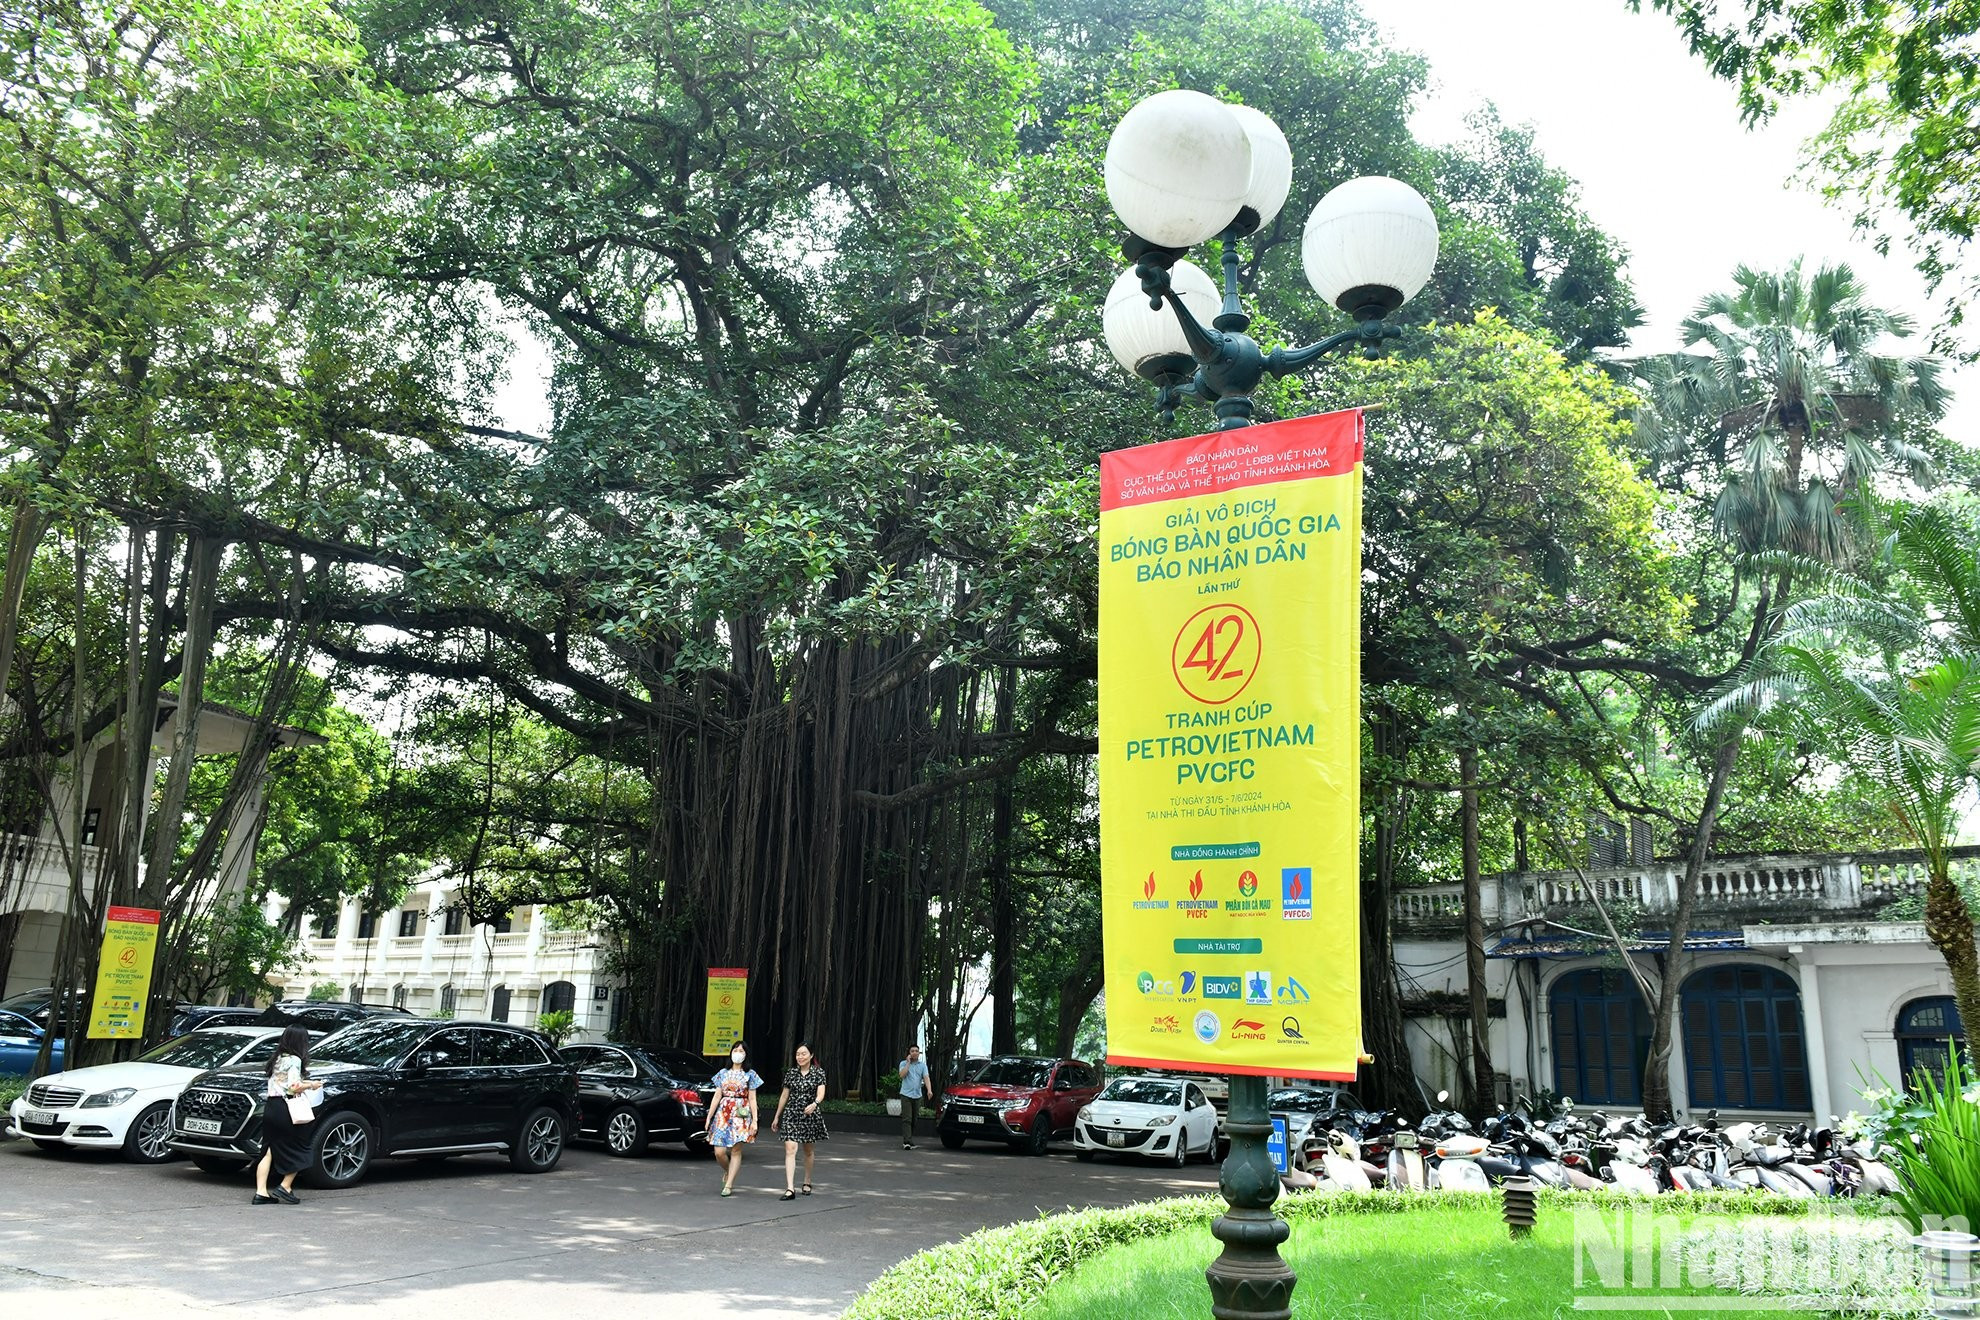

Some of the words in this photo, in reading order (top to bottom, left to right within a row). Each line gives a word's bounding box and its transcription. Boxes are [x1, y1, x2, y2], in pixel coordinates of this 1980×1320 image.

[1186, 453, 1206, 465] BÁO
[1208, 448, 1235, 461] NHÂN
[1237, 444, 1259, 456] DÂN
[1123, 476, 1144, 488] CỤC
[1146, 469, 1165, 483] THỂ
[1166, 469, 1188, 481] DỤC
[1190, 462, 1209, 476] THỂ
[1212, 460, 1237, 473] THAO
[1246, 454, 1274, 467] LĐBB
[1276, 449, 1300, 461] VIỆT
[1303, 447, 1327, 458] NAM
[1120, 488, 1134, 500] SỞ
[1135, 486, 1155, 497] VĂN
[1156, 482, 1176, 494] HÓA
[1178, 479, 1191, 490] VÀ
[1193, 474, 1213, 487] THỂ
[1216, 472, 1241, 484] THAO
[1243, 467, 1267, 478] TỈNH
[1268, 462, 1306, 475] KHÁNH
[1308, 458, 1330, 470] HÒA
[1165, 507, 1199, 528] GIẢI
[1206, 503, 1228, 522] VÔ
[1233, 498, 1276, 517] ĐỊCH
[1111, 536, 1168, 562] BÓNG
[1175, 527, 1220, 552] BÀN
[1227, 510, 1291, 544] QUỐC
[1298, 513, 1341, 534] GIA
[1137, 557, 1181, 582] BÁO
[1188, 547, 1248, 577] NHÂN
[1255, 538, 1306, 564] DÂN
[1198, 581, 1218, 595] LẦN
[1220, 578, 1241, 592] THỨ
[1181, 614, 1244, 681] 42
[1165, 709, 1230, 729] TRANH
[1235, 700, 1272, 723] CÚP
[1127, 724, 1314, 761] PETROVIETNAM
[1177, 758, 1255, 785] PVCFC
[1170, 796, 1182, 806] TỪ
[1182, 794, 1204, 805] NGÀY
[1205, 795, 1224, 804] 31/5
[1231, 792, 1262, 803] 7/6/2024
[1159, 808, 1179, 819] NHÀ
[1181, 809, 1195, 818] THI
[1197, 806, 1217, 817] ĐẤU
[1220, 805, 1240, 816] TỈNH
[1241, 802, 1271, 814] KHÁNH
[1272, 800, 1292, 811] HÒA
[1174, 849, 1190, 858] NHÀ
[1191, 847, 1213, 858] ĐỒNG
[1215, 847, 1238, 857] HÀNH
[1132, 900, 1169, 909] PETROVIETNAM
[1176, 900, 1219, 909] PETROVIETNAM
[1186, 909, 1208, 919] PVCFC
[1198, 942, 1214, 951] NHÀ
[1215, 942, 1227, 951] TÀI
[1227, 942, 1241, 952] TRỢ
[121, 949, 135, 964] 42
[597, 987, 606, 998] B
[1143, 979, 1174, 995] BCG
[1206, 983, 1231, 995] BIDV
[1231, 1032, 1266, 1040] LI-NING
